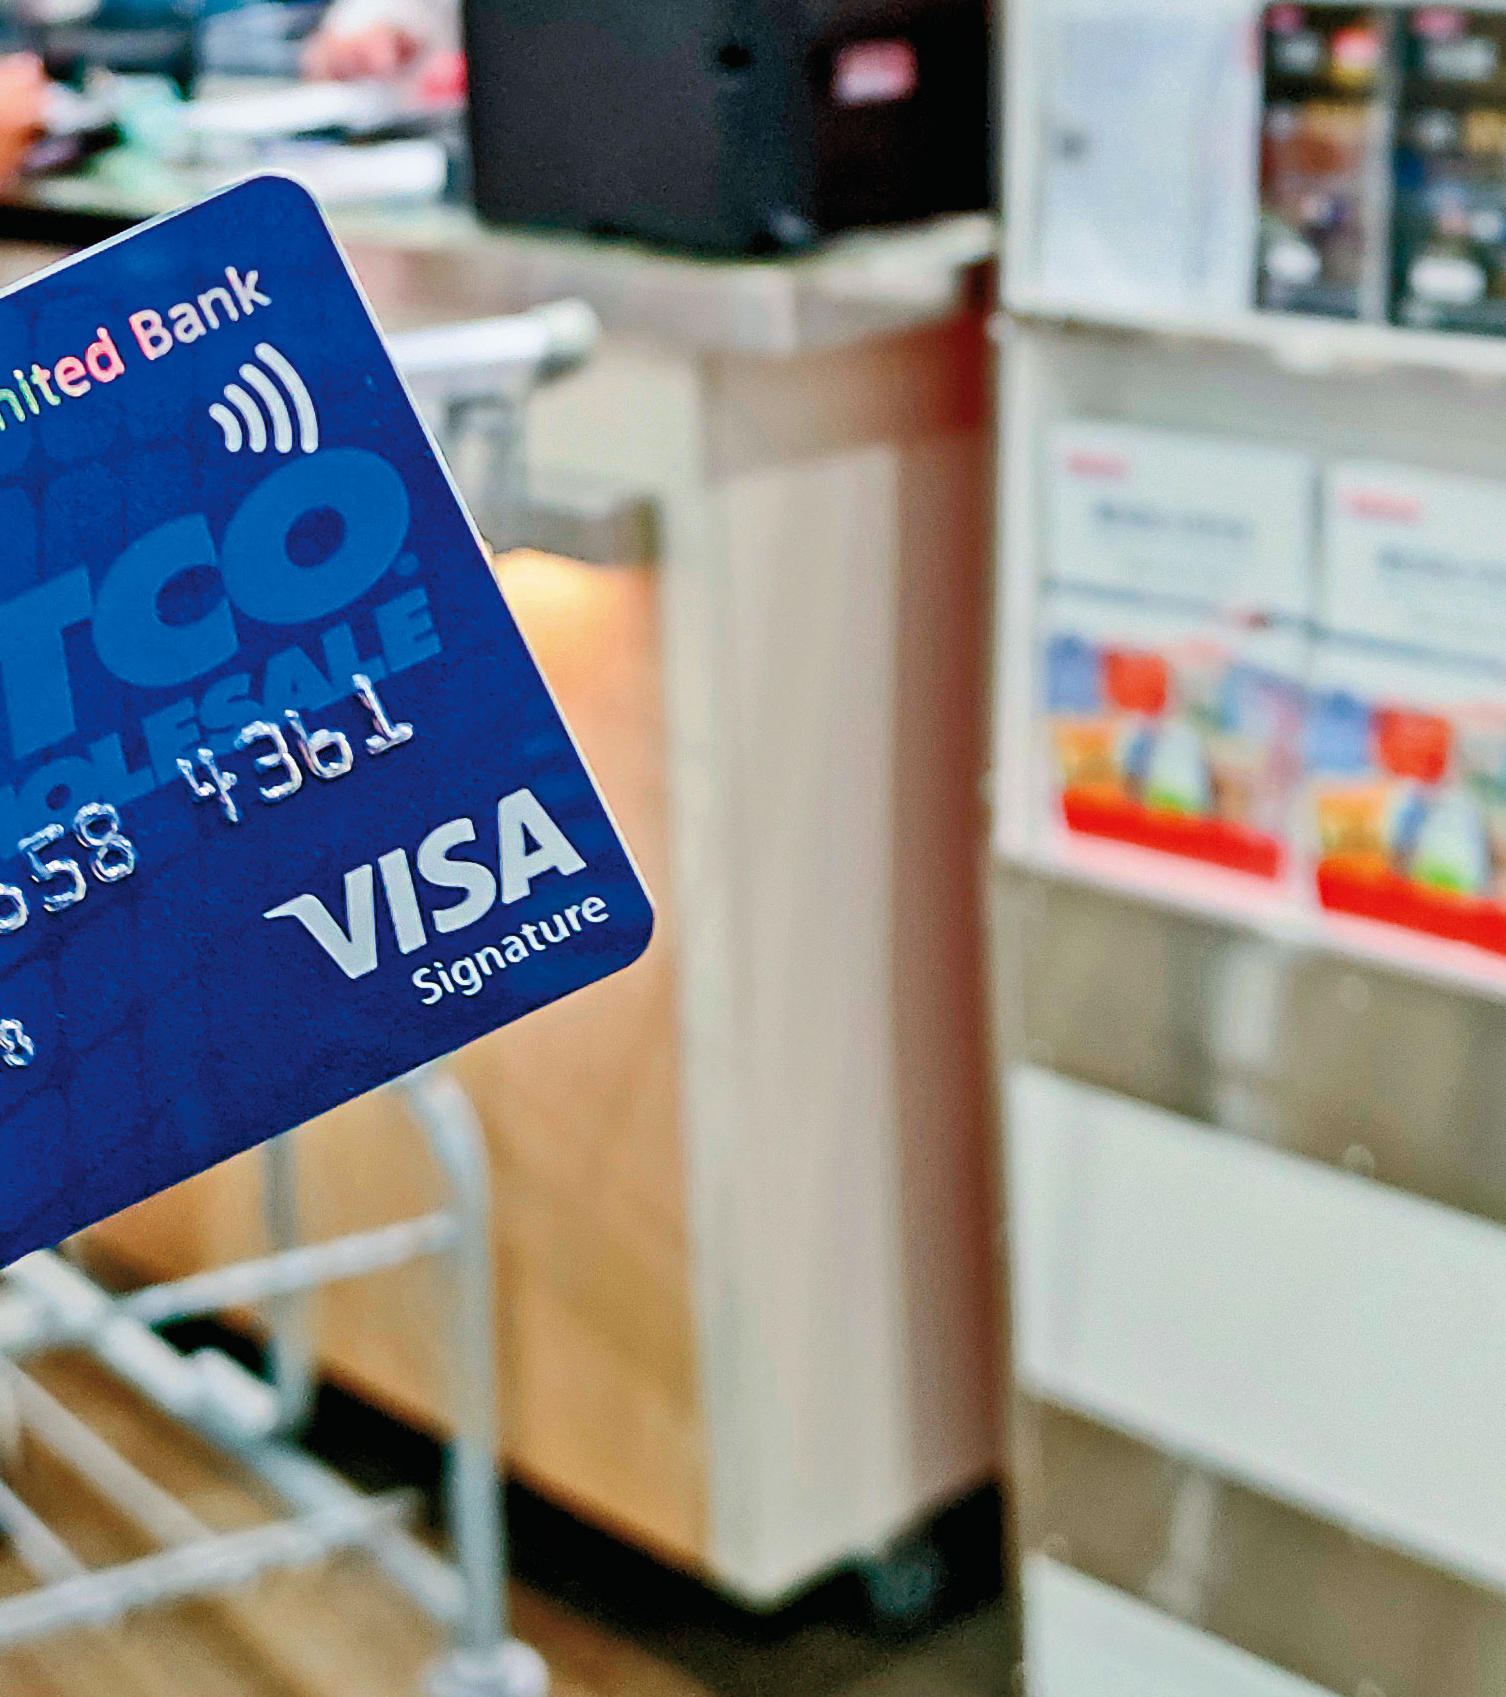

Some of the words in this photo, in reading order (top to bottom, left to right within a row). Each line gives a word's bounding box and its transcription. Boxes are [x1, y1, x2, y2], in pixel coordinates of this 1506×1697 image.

[128, 265, 273, 361] Bank
[175, 674, 416, 824] 4361
[262, 787, 588, 980] VISA
[411, 895, 610, 1005] Signature
